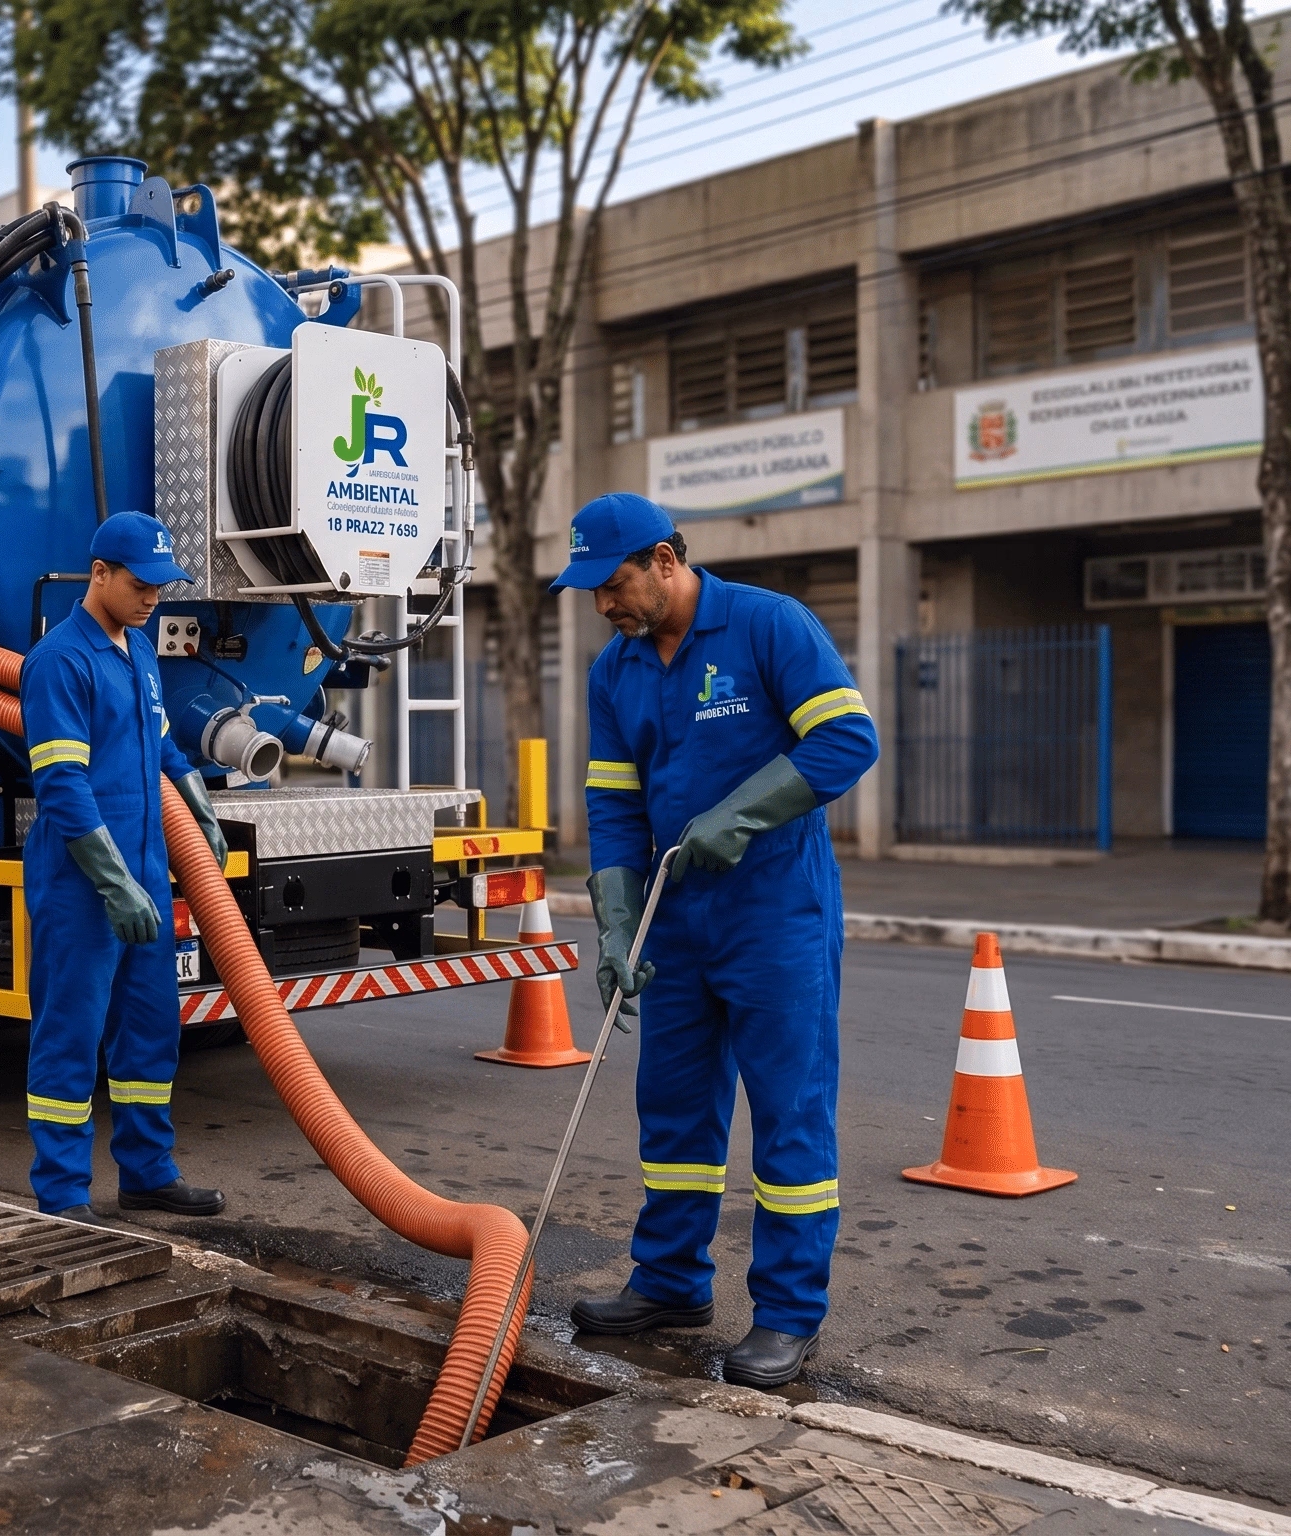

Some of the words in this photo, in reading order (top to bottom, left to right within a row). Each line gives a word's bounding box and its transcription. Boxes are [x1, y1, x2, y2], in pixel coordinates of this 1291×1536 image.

[333, 395, 409, 467] JR
[327, 481, 419, 506] AMBIENTAL
[346, 519, 385, 535] PRA22
[698, 672, 737, 701] JR
